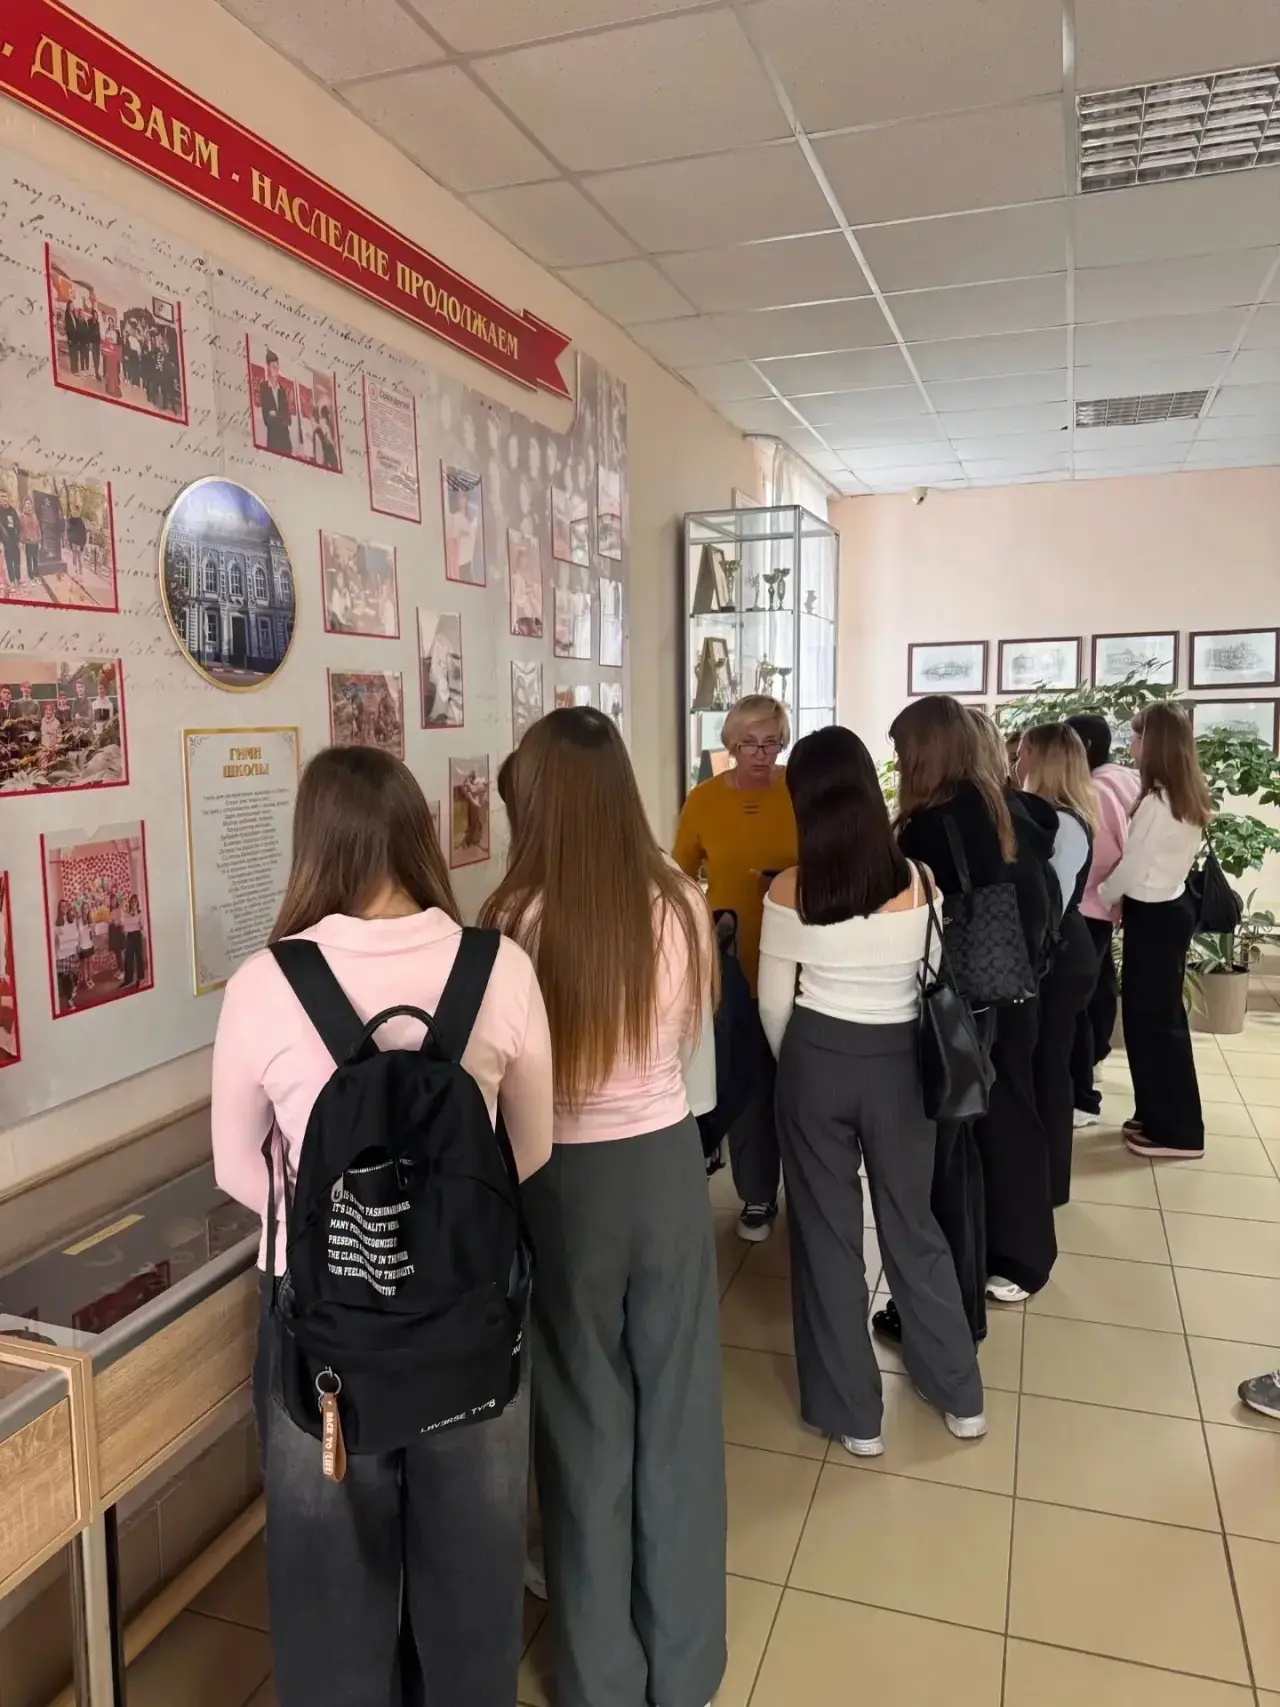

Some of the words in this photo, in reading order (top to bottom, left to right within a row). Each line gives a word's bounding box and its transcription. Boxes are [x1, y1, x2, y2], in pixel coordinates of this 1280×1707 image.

[30, 33, 221, 180] ДЕРЗАЕМ
[250, 167, 391, 280] НАСЛЕДИЕ
[395, 262, 520, 361] ПРОДОЛЖАЕМ
[229, 746, 262, 761] ГИМН
[222, 763, 269, 778] ШКОЛЫ
[332, 1202, 345, 1214] IT'S
[329, 1218, 349, 1231] MANY
[328, 1234, 359, 1249] PRESENTS
[327, 1249, 340, 1260] THE
[327, 1262, 343, 1276] YOUR
[325, 1436, 333, 1450] TO
